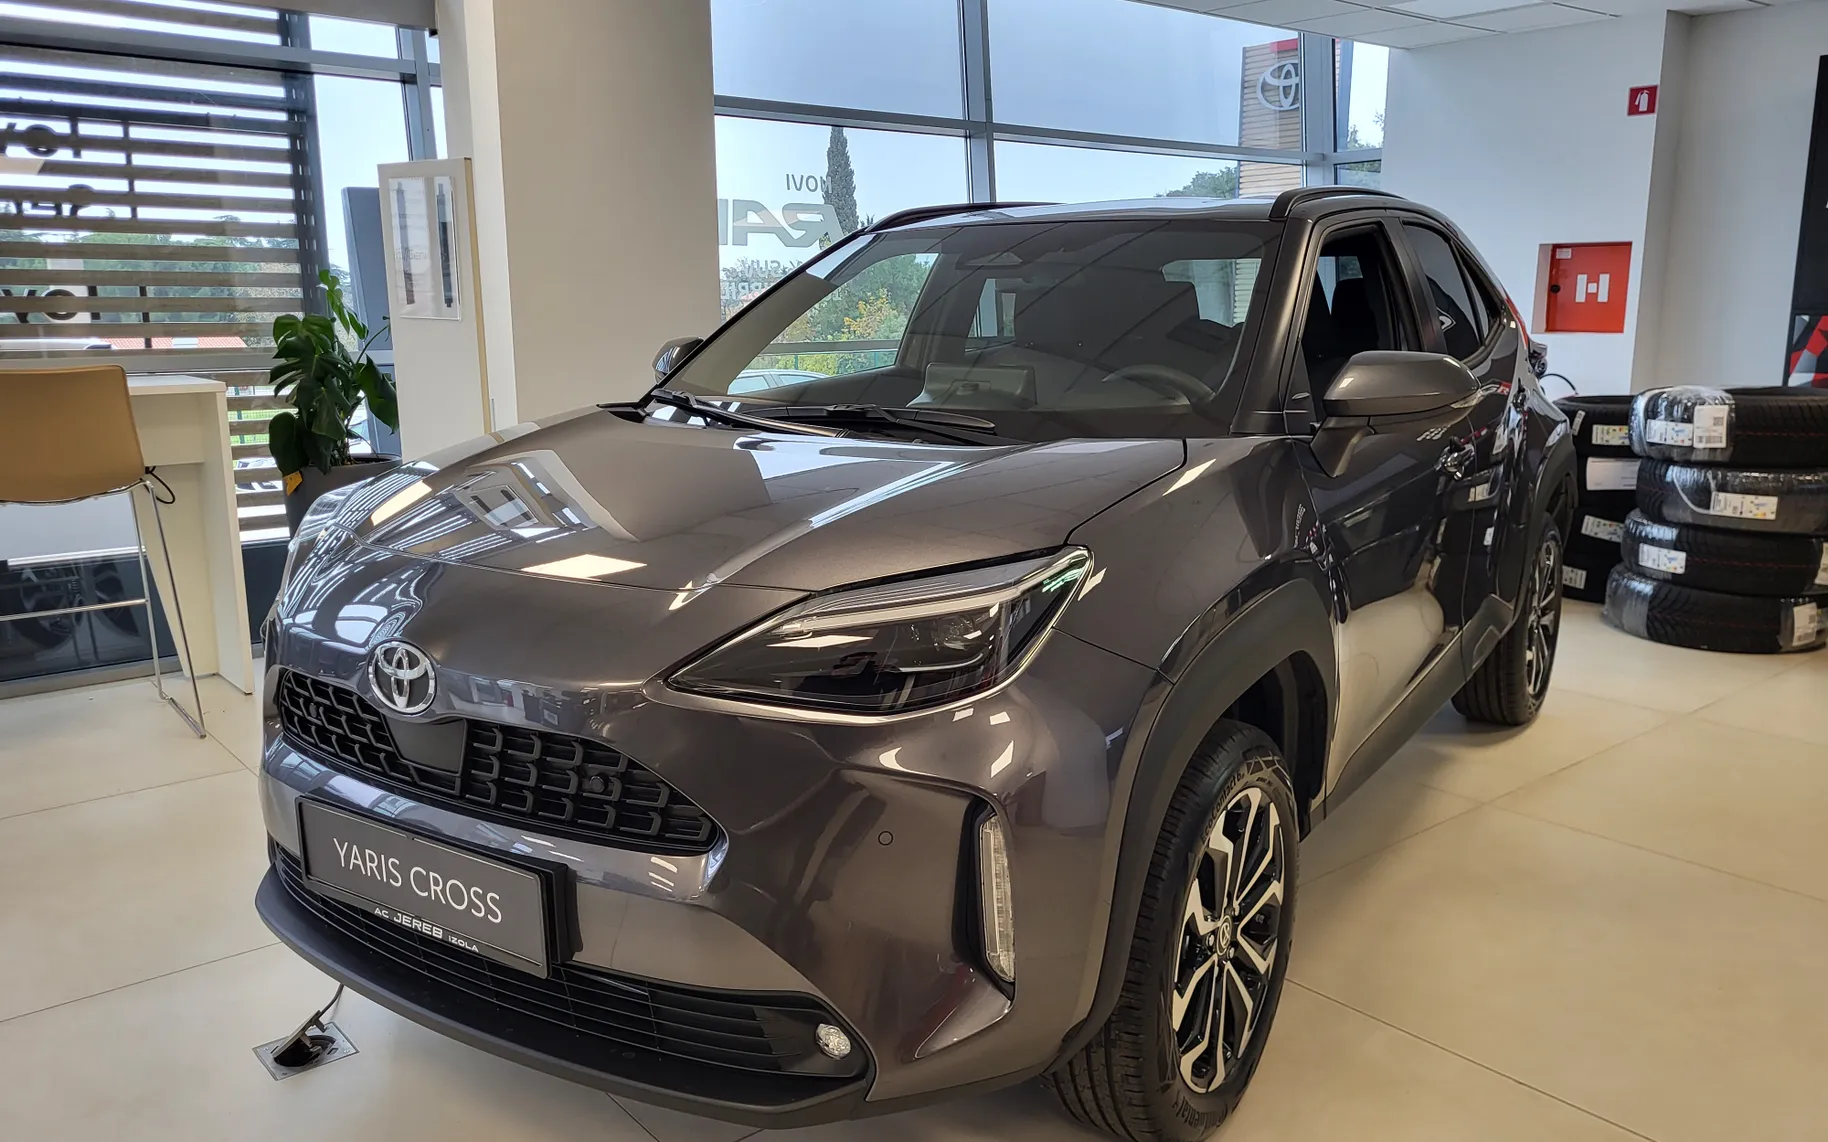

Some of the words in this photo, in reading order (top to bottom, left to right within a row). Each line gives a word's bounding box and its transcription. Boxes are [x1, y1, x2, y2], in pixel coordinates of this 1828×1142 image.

[332, 837, 402, 887] YARIS
[409, 866, 502, 924] CROSS
[374, 907, 389, 919] AC
[393, 912, 443, 939] JEREB
[448, 935, 479, 953] IZOLA
